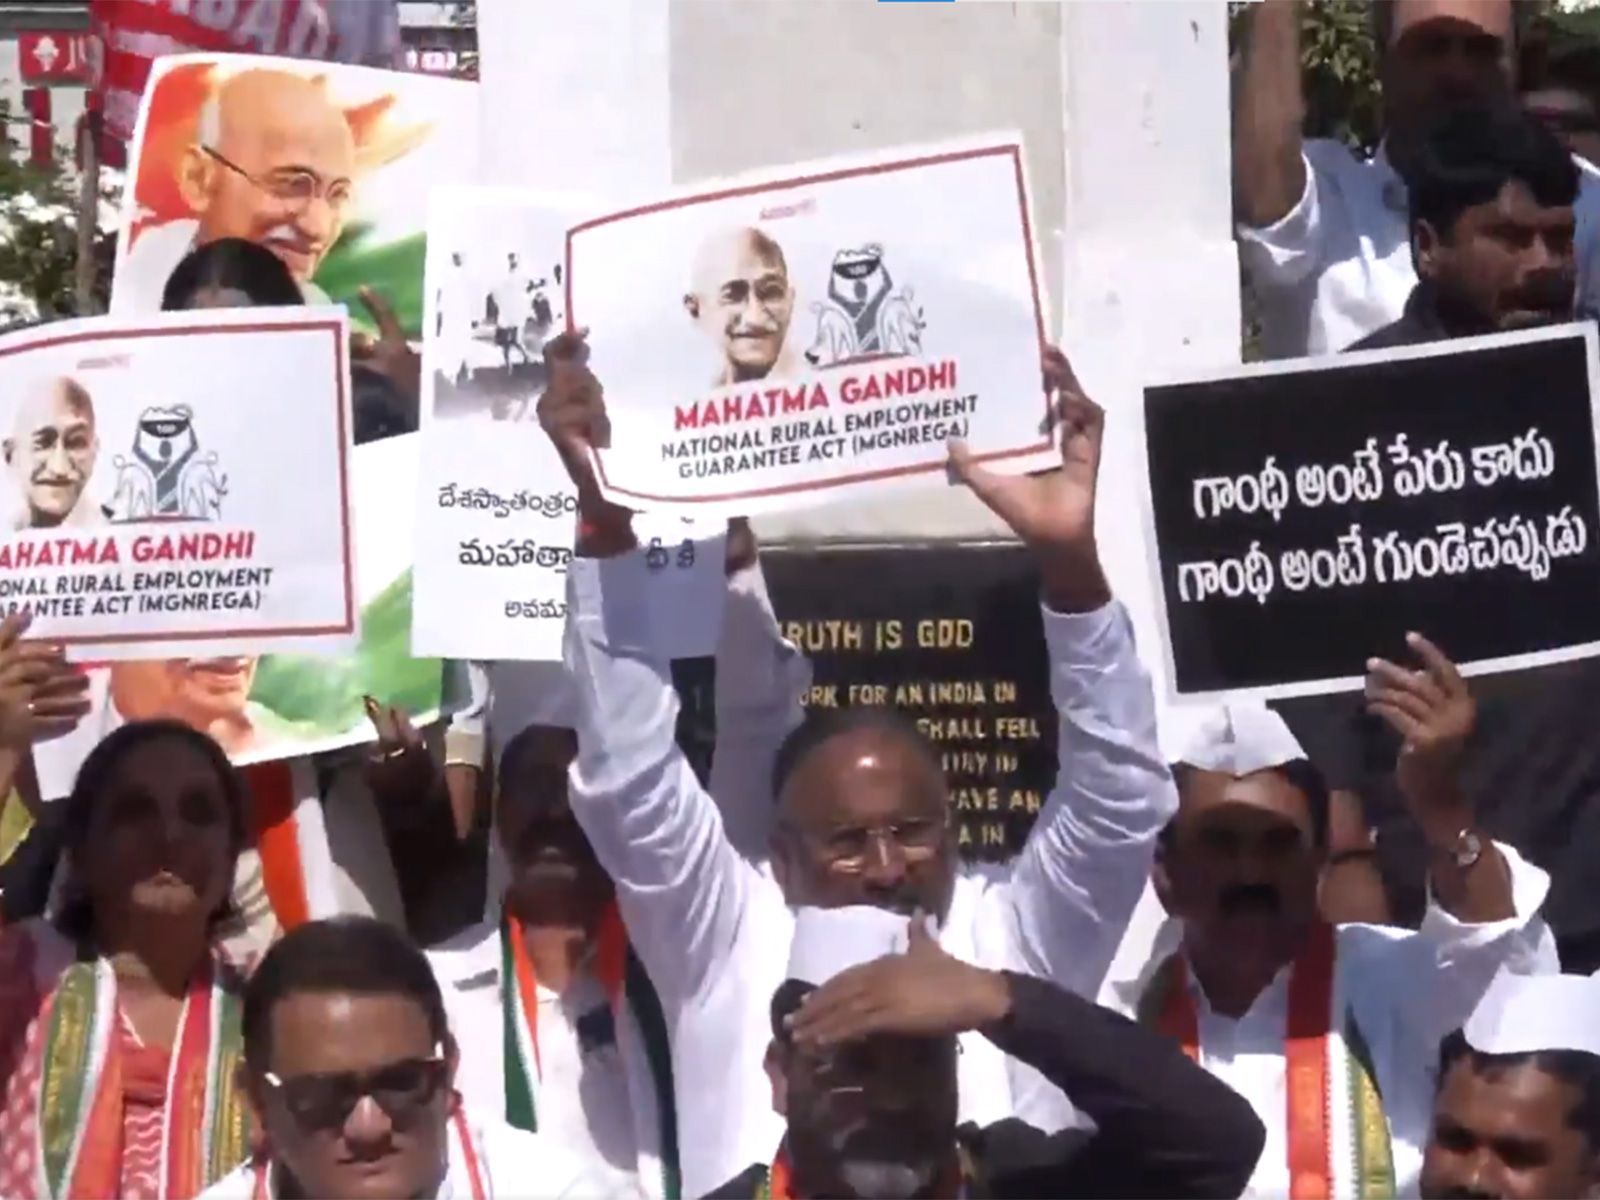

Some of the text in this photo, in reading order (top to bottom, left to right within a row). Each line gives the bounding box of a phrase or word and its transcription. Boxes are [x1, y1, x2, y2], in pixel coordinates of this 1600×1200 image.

[674, 360, 957, 430] MAHATMA GANDHI
[661, 394, 978, 461] NATIONAL RURAL EMPLOYMENT
[679, 419, 970, 479] GUARANTEE ACT (MGNREGA)
[1192, 427, 1555, 521] గాంధీ అంటే పేరు కాదు
[0, 531, 255, 570] AHATMA GANDHI
[1177, 506, 1588, 604] గాంధీ అంటే గుండెచప్పుడు
[0, 568, 273, 597] ONAL RURAL EMPLOYMENT
[92, 596, 133, 614] ACT
[139, 592, 261, 612] (MGNREGA)
[875, 619, 903, 652] IS
[917, 619, 973, 648] GOD
[799, 681, 1016, 707] ORK FOR AN INDIA IN
[1009, 789, 1040, 814] AN
[981, 823, 1004, 845] IN
